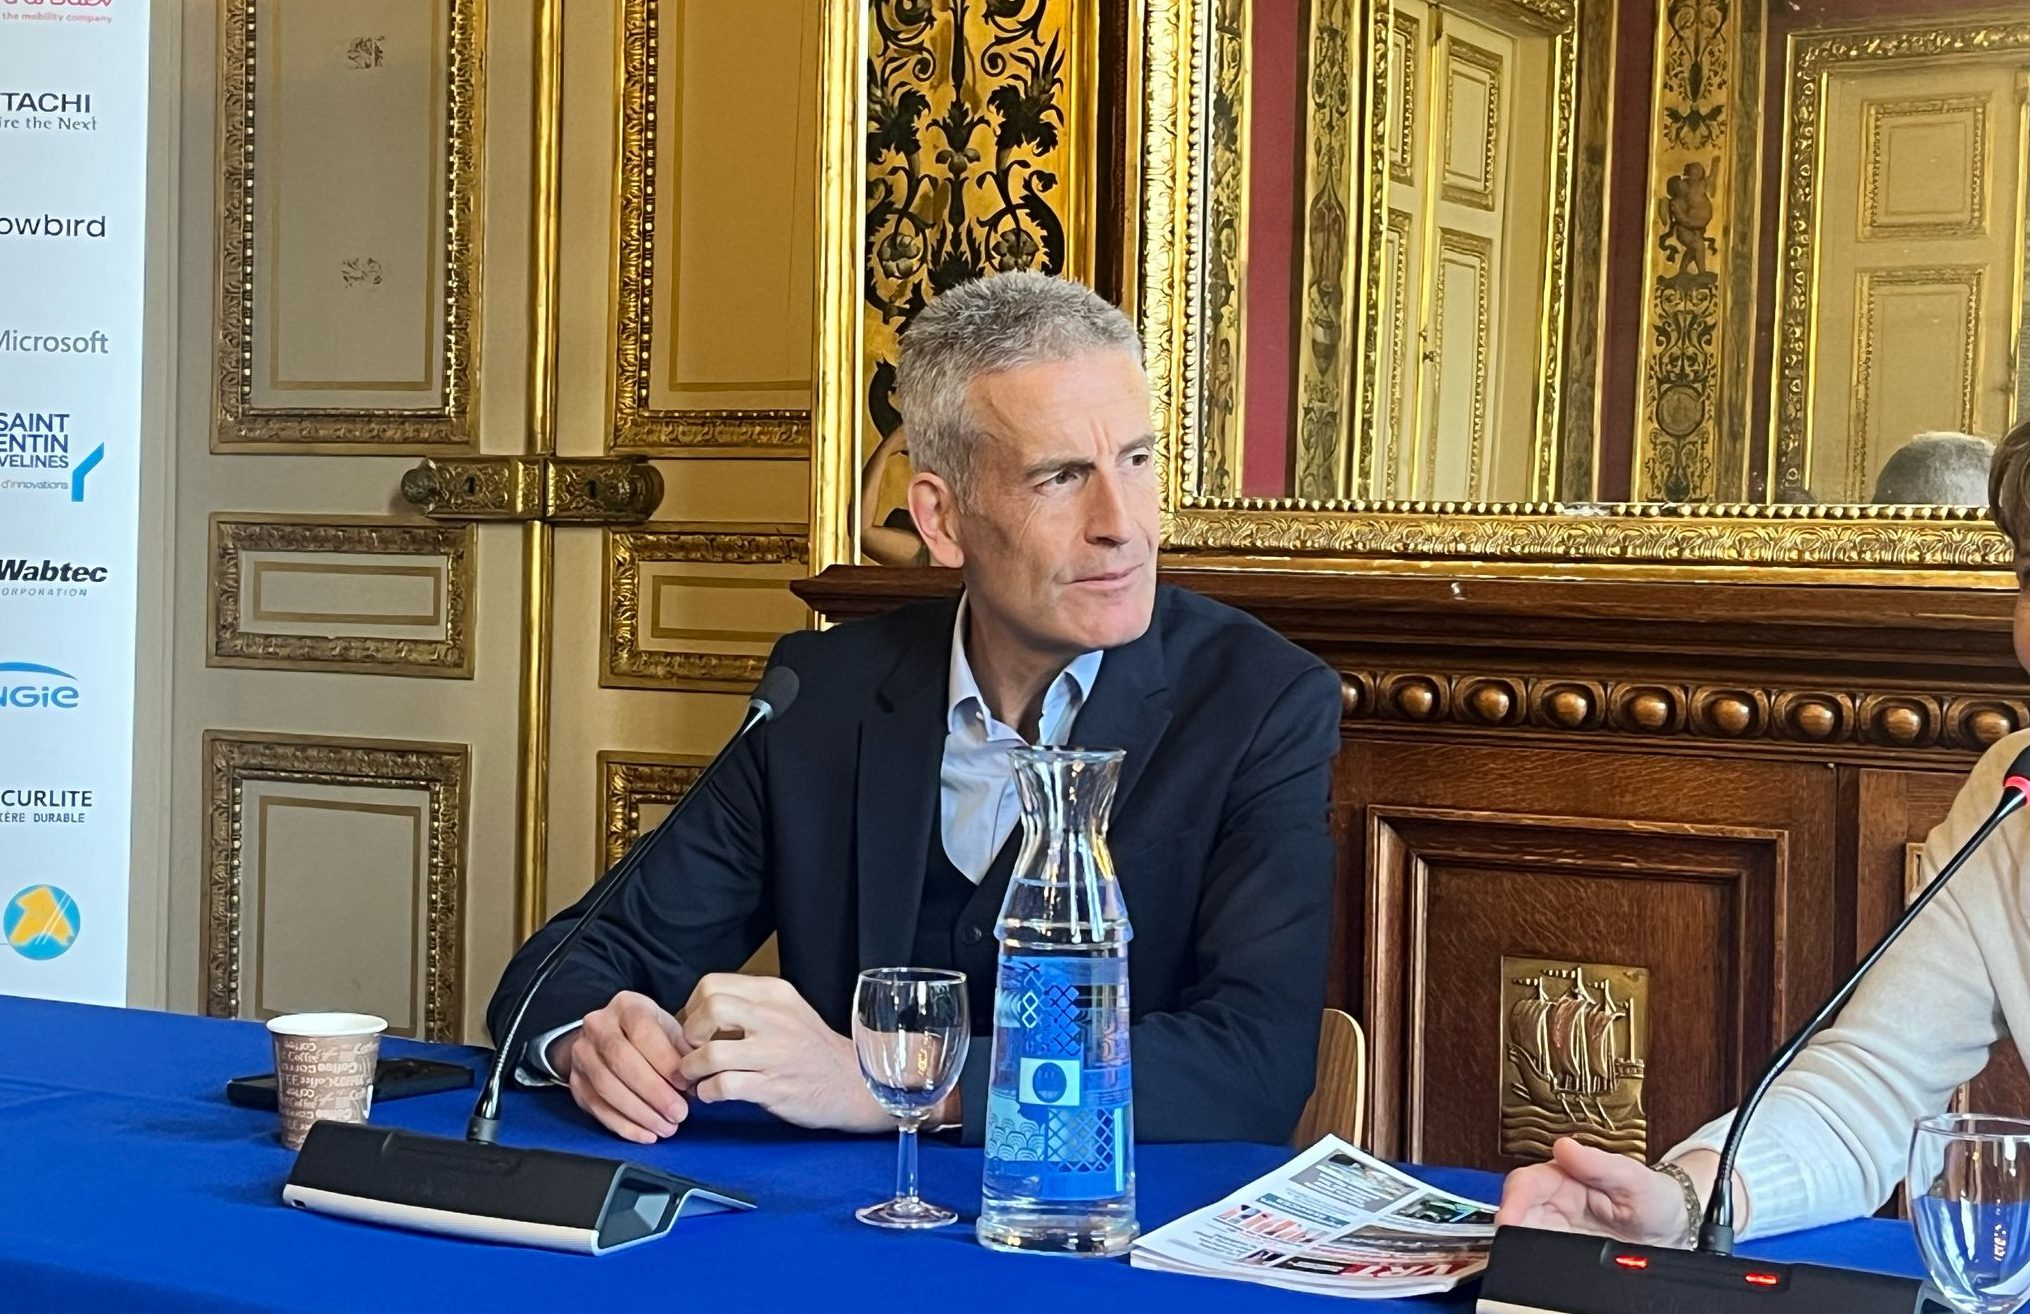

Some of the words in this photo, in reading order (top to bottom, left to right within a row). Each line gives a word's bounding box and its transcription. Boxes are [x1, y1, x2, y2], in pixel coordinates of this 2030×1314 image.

[0, 92, 91, 113] TACHI
[26, 116, 52, 130] the
[58, 116, 97, 131] Next
[0, 412, 70, 432] SAINT
[0, 560, 108, 582] Wabtec
[1, 587, 87, 597] ORPORATION
[1, 789, 92, 807] CURLITE
[34, 813, 85, 823] DURABLE
